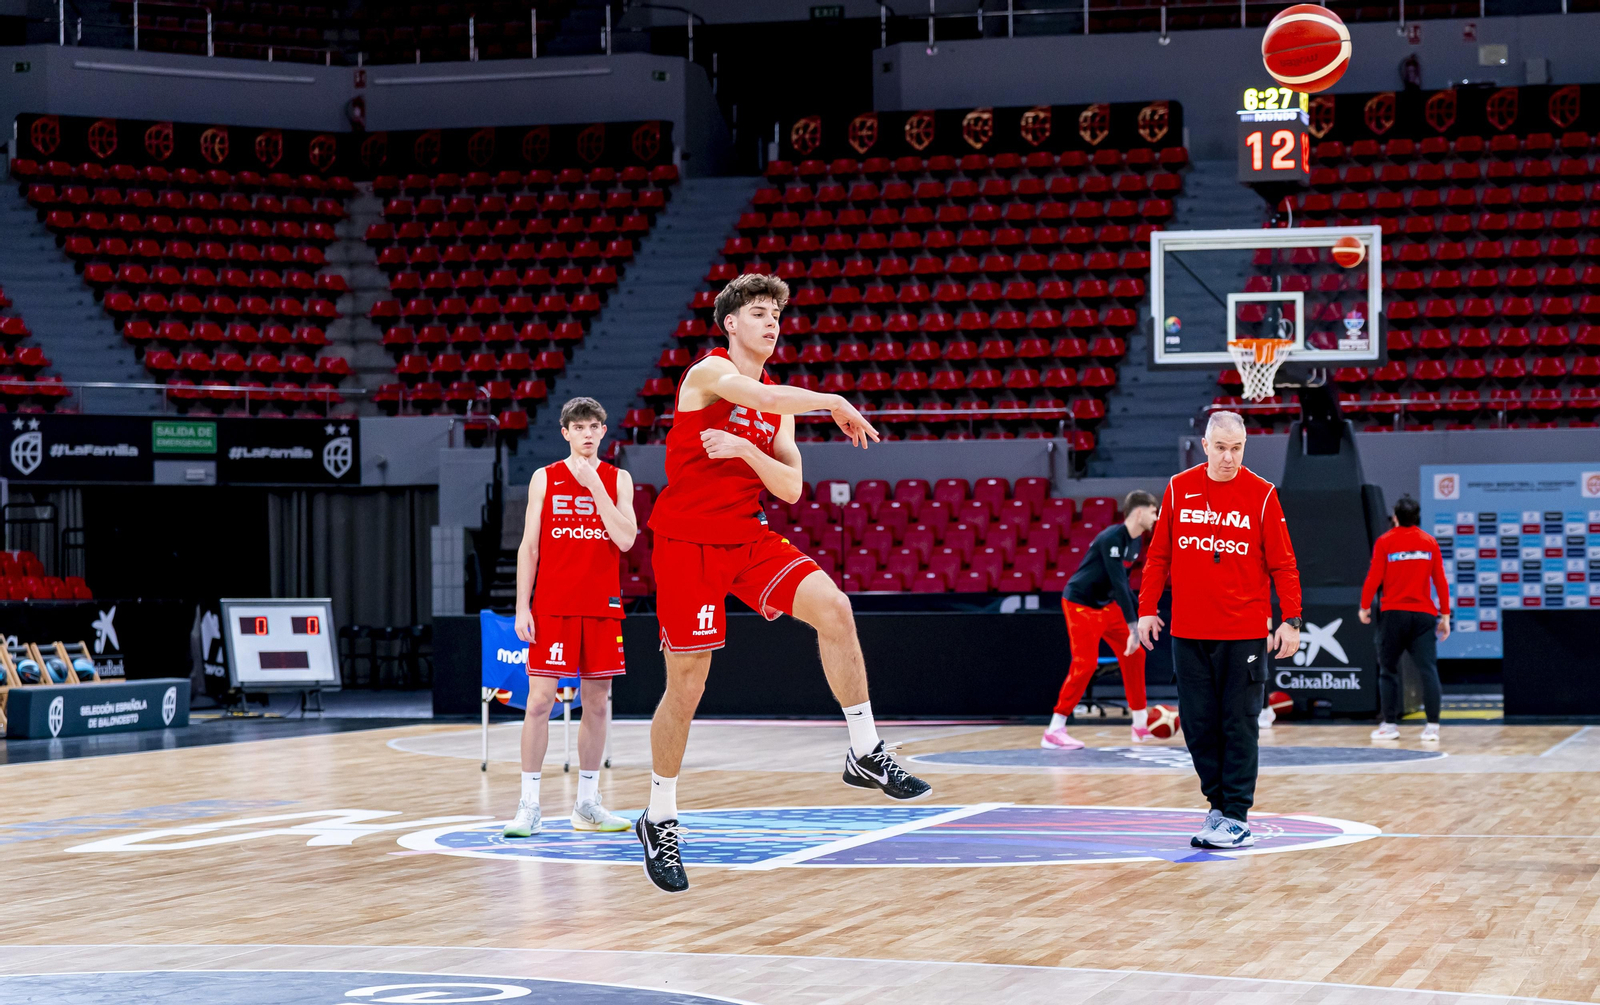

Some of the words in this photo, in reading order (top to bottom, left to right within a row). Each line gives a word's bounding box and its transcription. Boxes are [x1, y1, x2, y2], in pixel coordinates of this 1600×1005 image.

[1243, 87, 1293, 111] 6:27
[1245, 129, 1296, 170] 12
[156, 426, 196, 437] SALIDA
[197, 426, 213, 438] DE
[50, 443, 139, 458] #LaFamilia
[156, 438, 213, 447] EMERGENCIA
[228, 446, 314, 460] #LaFamilia
[552, 494, 600, 516] ES
[1179, 508, 1251, 530] ESPAÑA
[1178, 534, 1250, 555] endesa
[255, 616, 268, 636] 0
[306, 616, 319, 636] 0
[697, 604, 716, 630] fi
[692, 627, 718, 636] network
[549, 642, 564, 661] fi
[1275, 670, 1361, 690] CaixaBank
[80, 701, 115, 716] SELECCIÓN
[115, 698, 148, 713] ESPAÑOLA
[88, 717, 98, 729] DE
[98, 712, 139, 728] BALONCESTO
